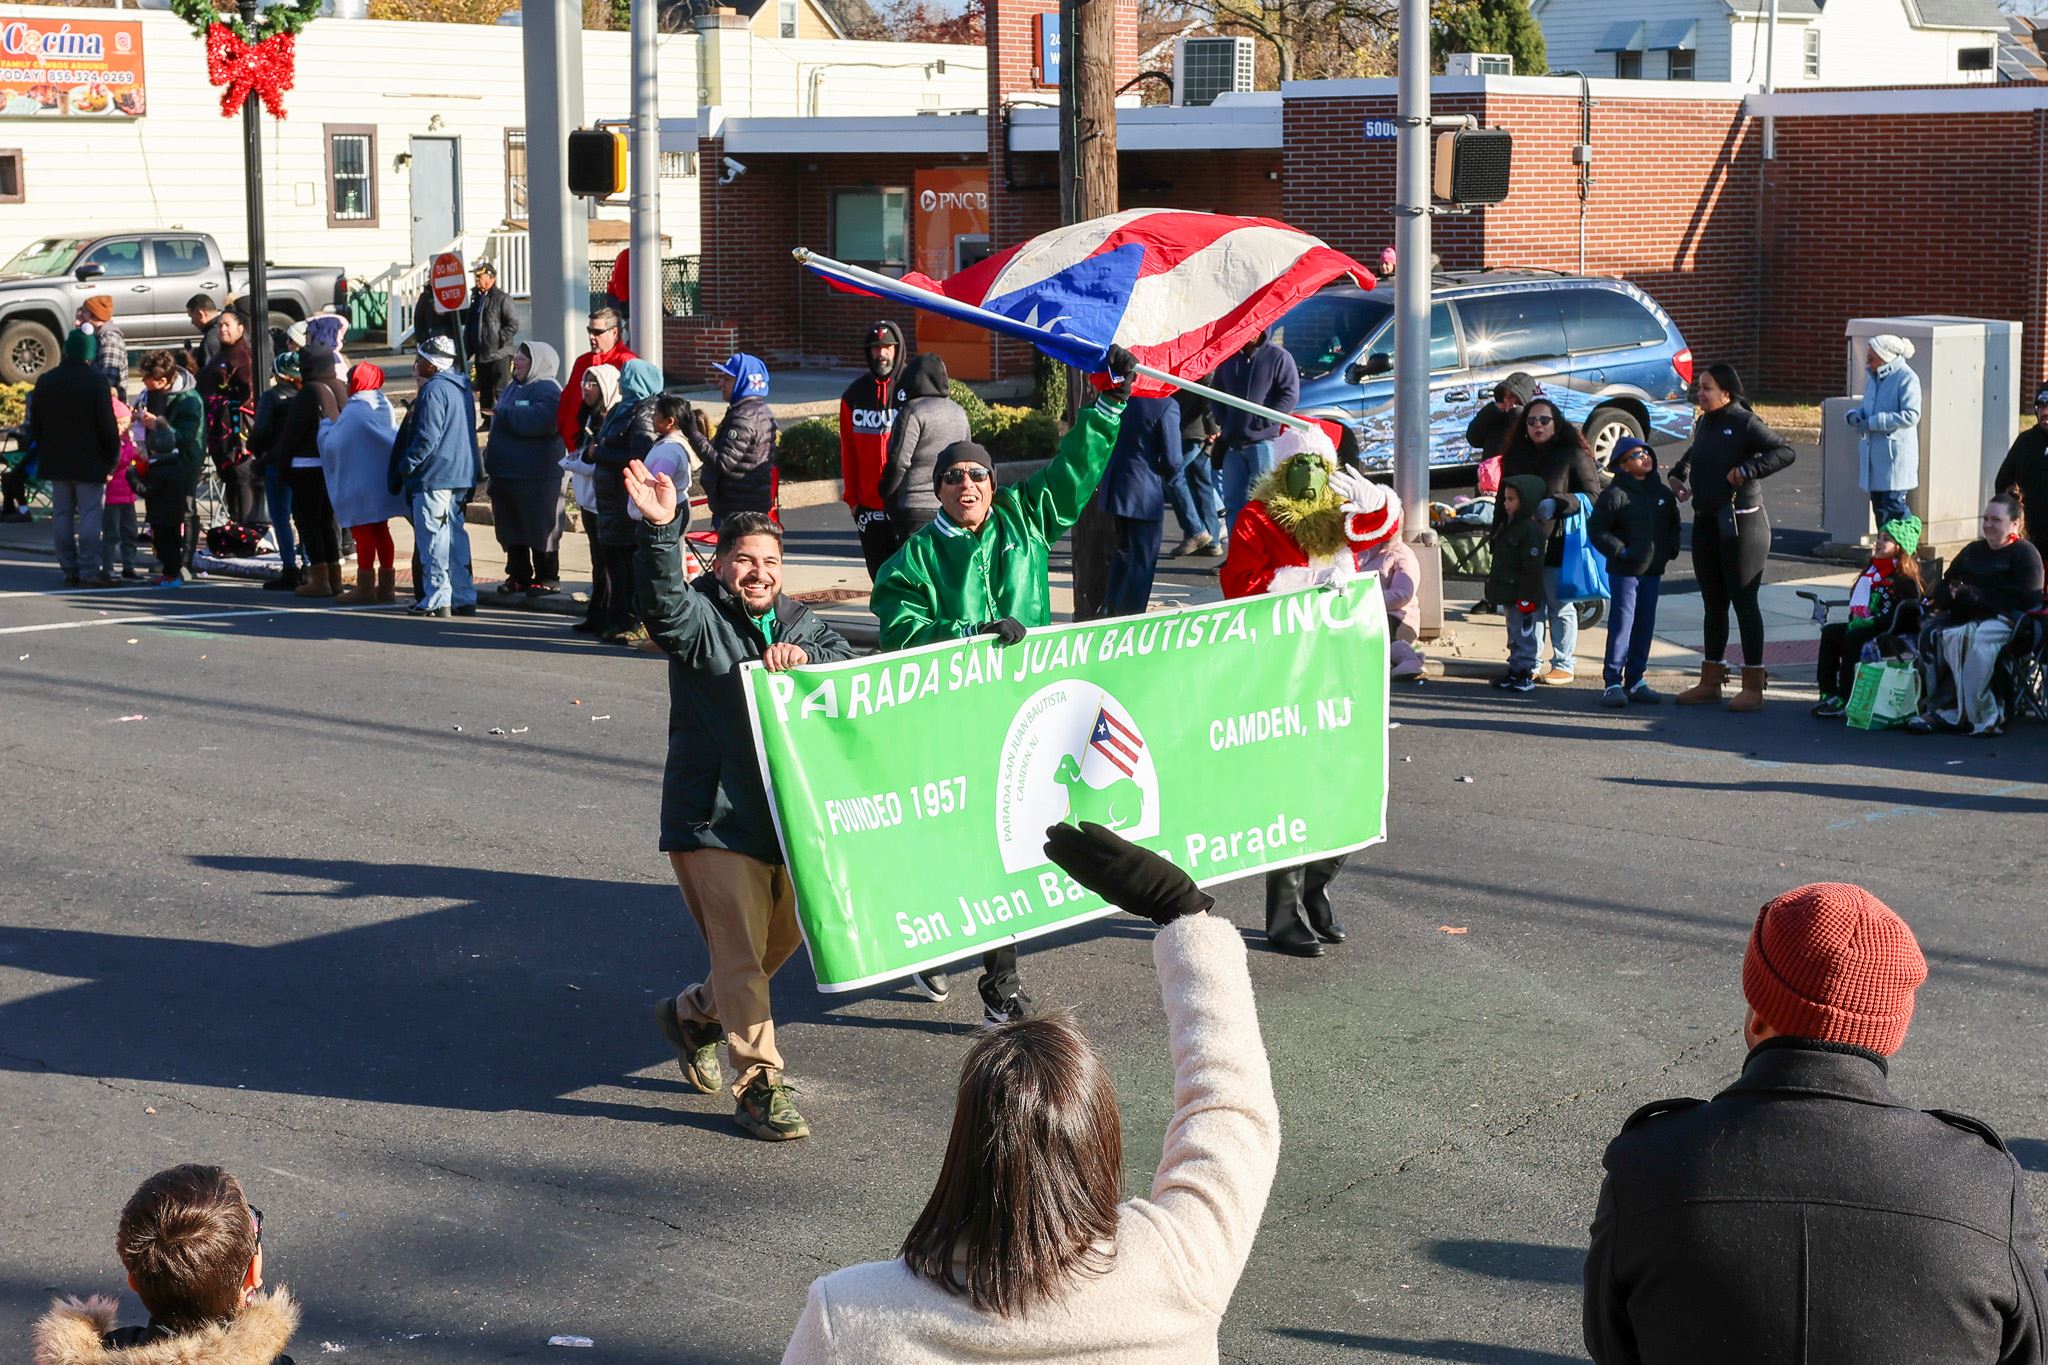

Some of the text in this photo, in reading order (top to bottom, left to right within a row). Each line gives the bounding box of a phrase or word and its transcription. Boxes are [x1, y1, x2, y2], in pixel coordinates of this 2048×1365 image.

[0, 70, 133, 82] ODAY! 856.324.0269
[1366, 121, 1398, 136] 5000
[436, 262, 459, 275] DO NOT
[441, 288, 461, 301] ENTER
[768, 658, 940, 724] PARADA
[948, 643, 1004, 692] SAN
[1013, 631, 1095, 683] JUAN
[1098, 607, 1257, 662] BAUTISTA,
[1209, 696, 1353, 752] CAMDEN, NJ
[1001, 690, 1067, 842] PARADA SAN JUAN BAUTISTA
[824, 775, 968, 836] FOUNDED 1957
[896, 911, 953, 949] San
[957, 888, 1034, 937] Juan
[1185, 813, 1308, 868] Parade
